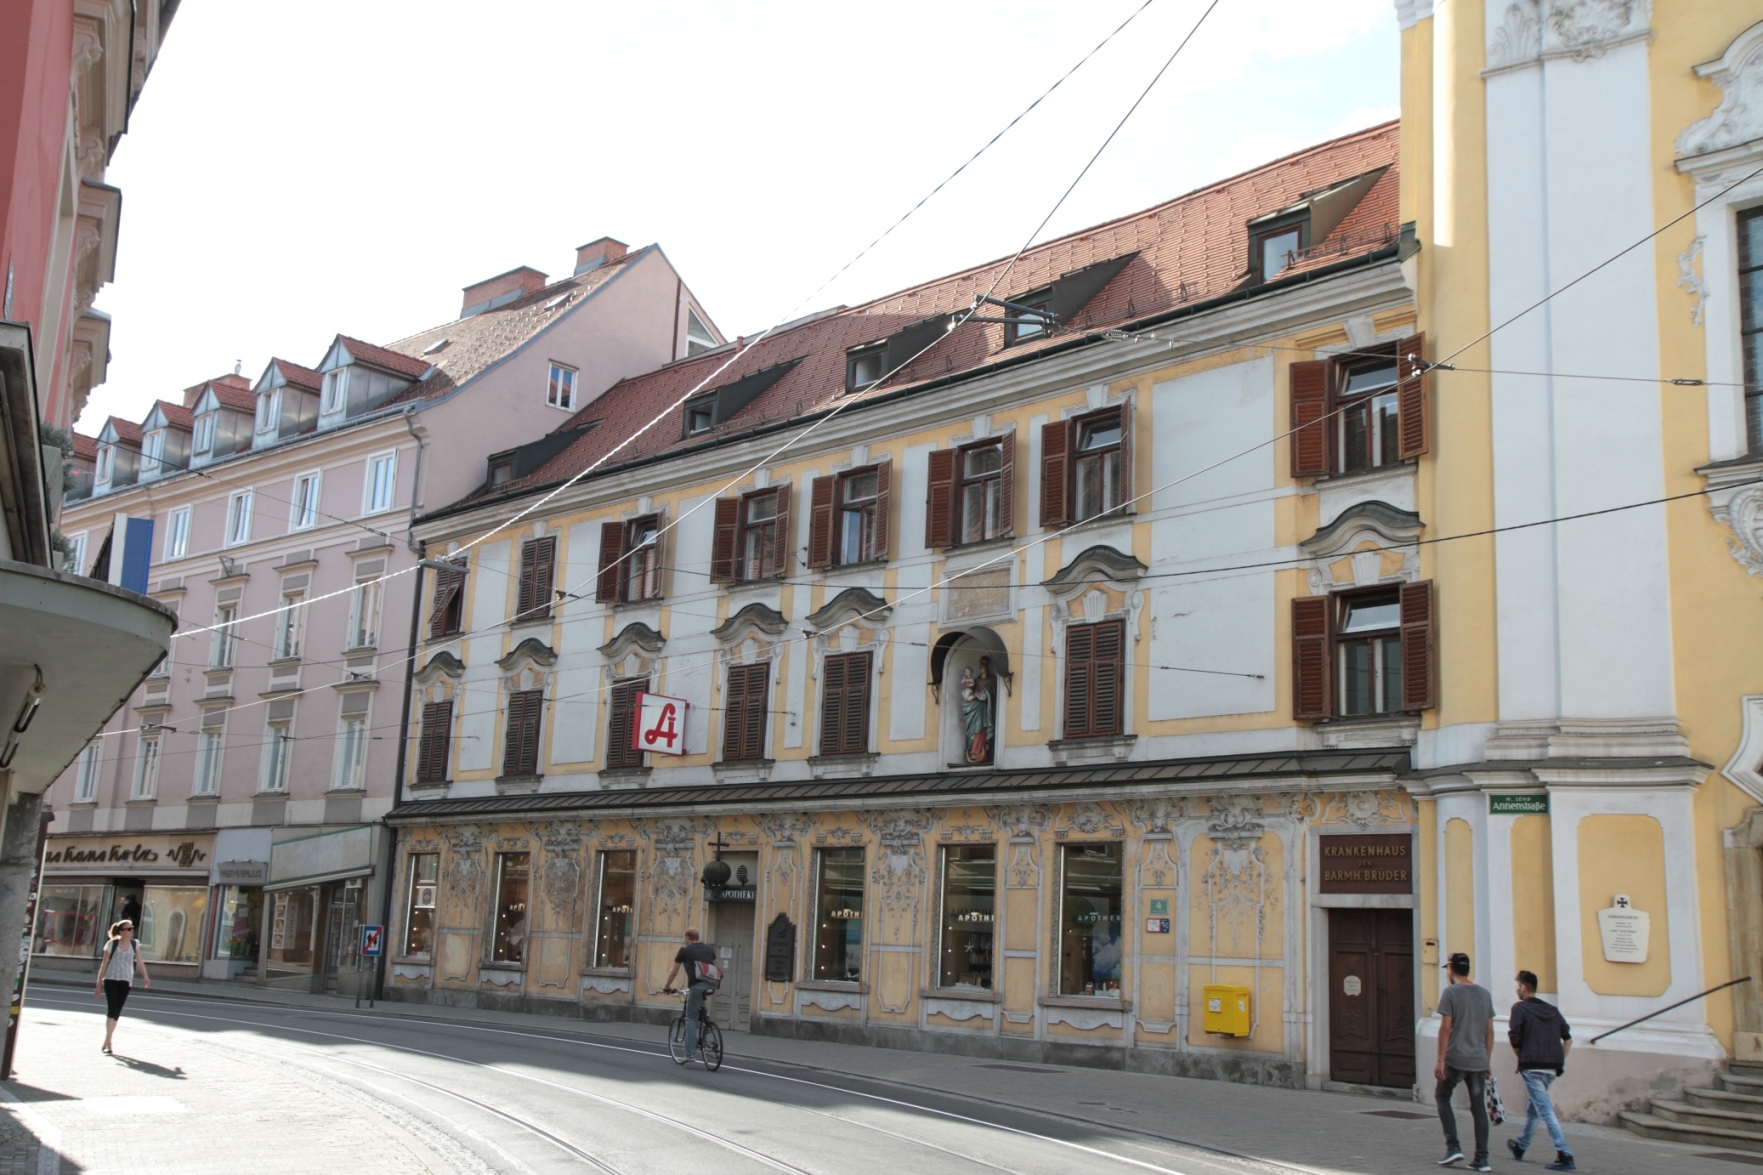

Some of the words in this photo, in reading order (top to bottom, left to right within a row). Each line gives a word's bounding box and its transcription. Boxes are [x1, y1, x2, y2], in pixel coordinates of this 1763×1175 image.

[1492, 801, 1547, 812] Annenstraße
[1324, 845, 1407, 857] KRANKENHAUS
[1324, 870, 1362, 881] BARMH.
[1364, 868, 1408, 881] BRÜDER
[720, 890, 755, 899] APOTHEKE
[1155, 901, 1162, 910] 4
